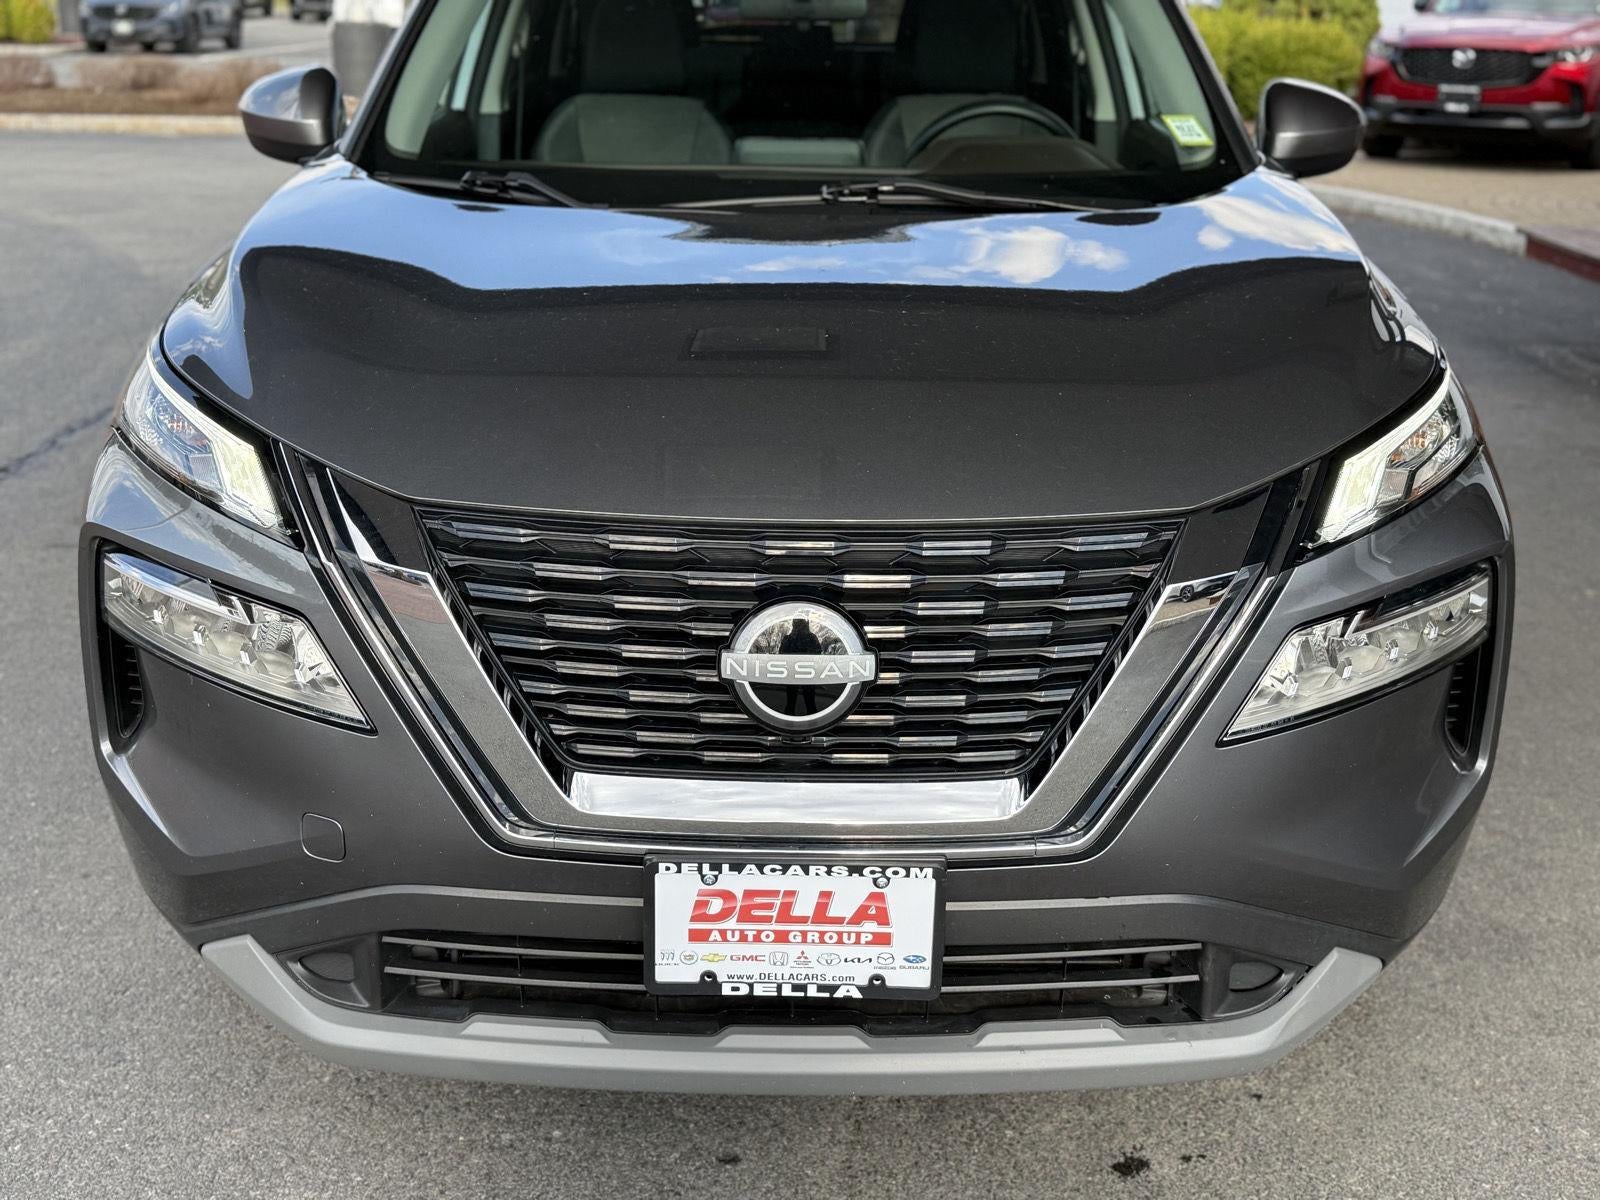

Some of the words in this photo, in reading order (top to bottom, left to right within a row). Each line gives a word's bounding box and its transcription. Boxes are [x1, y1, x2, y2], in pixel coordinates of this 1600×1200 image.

[726, 657, 870, 678] NISSAN
[658, 862, 933, 880] DELLACARS.COM
[688, 888, 893, 928] DELLA
[708, 929, 776, 943] AUTO
[788, 931, 875, 945] GROUP
[729, 954, 766, 962] GMC
[726, 972, 856, 983] www.DELLACARS.com
[721, 982, 864, 999] DELLA
